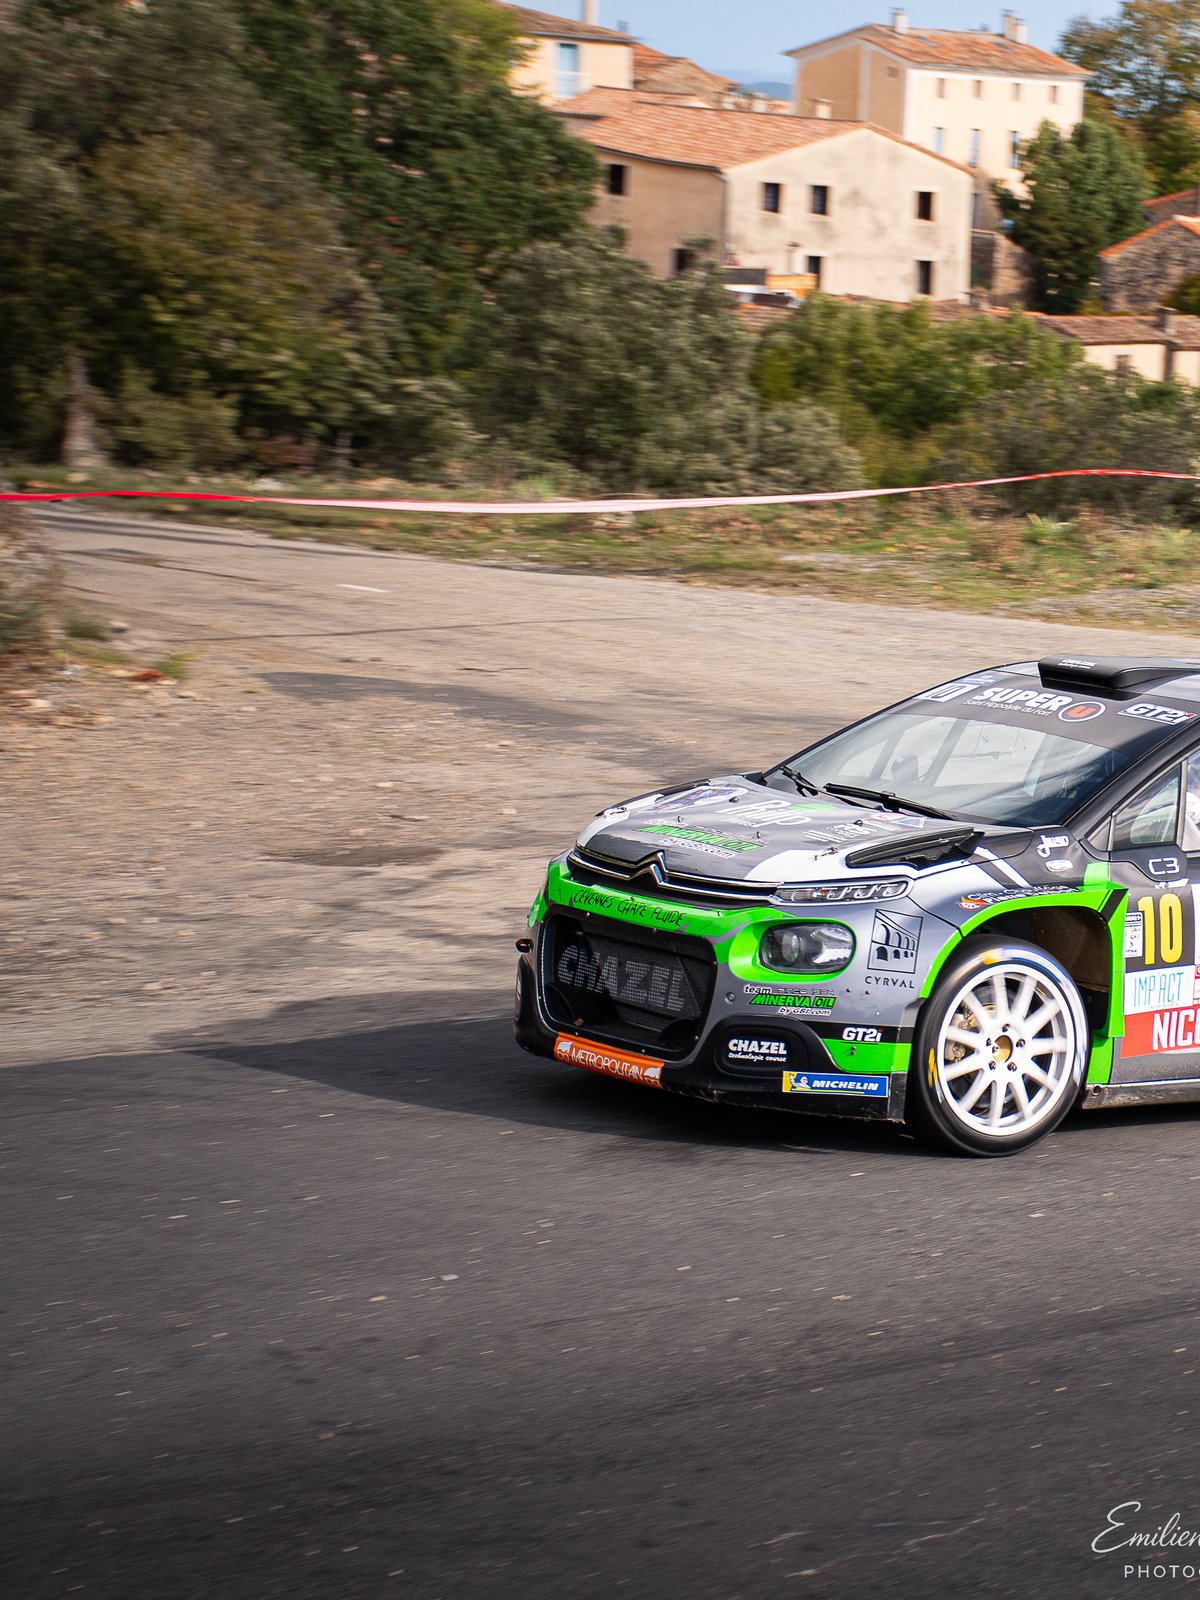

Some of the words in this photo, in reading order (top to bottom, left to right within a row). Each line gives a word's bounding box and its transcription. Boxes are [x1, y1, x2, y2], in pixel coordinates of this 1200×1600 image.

[972, 686, 1074, 713] SUPER
[1125, 702, 1198, 724] GT2i
[1148, 857, 1180, 875] C3
[573, 889, 615, 909] CEVENNES
[617, 899, 648, 918] CHAPE
[650, 907, 688, 927] FLUIDE
[1137, 892, 1184, 966] 10
[557, 943, 685, 1013] CHAZEL
[864, 974, 916, 990] CYRVAL
[743, 984, 773, 995] team
[751, 993, 812, 1008] MINERVA
[812, 995, 834, 1009] OIL
[778, 1006, 792, 1015] by
[842, 1026, 883, 1042] GT2i
[728, 1038, 788, 1055] CHAZEL
[571, 1046, 645, 1081] METROPOLITAN
[811, 1079, 880, 1092] MICHELIN
